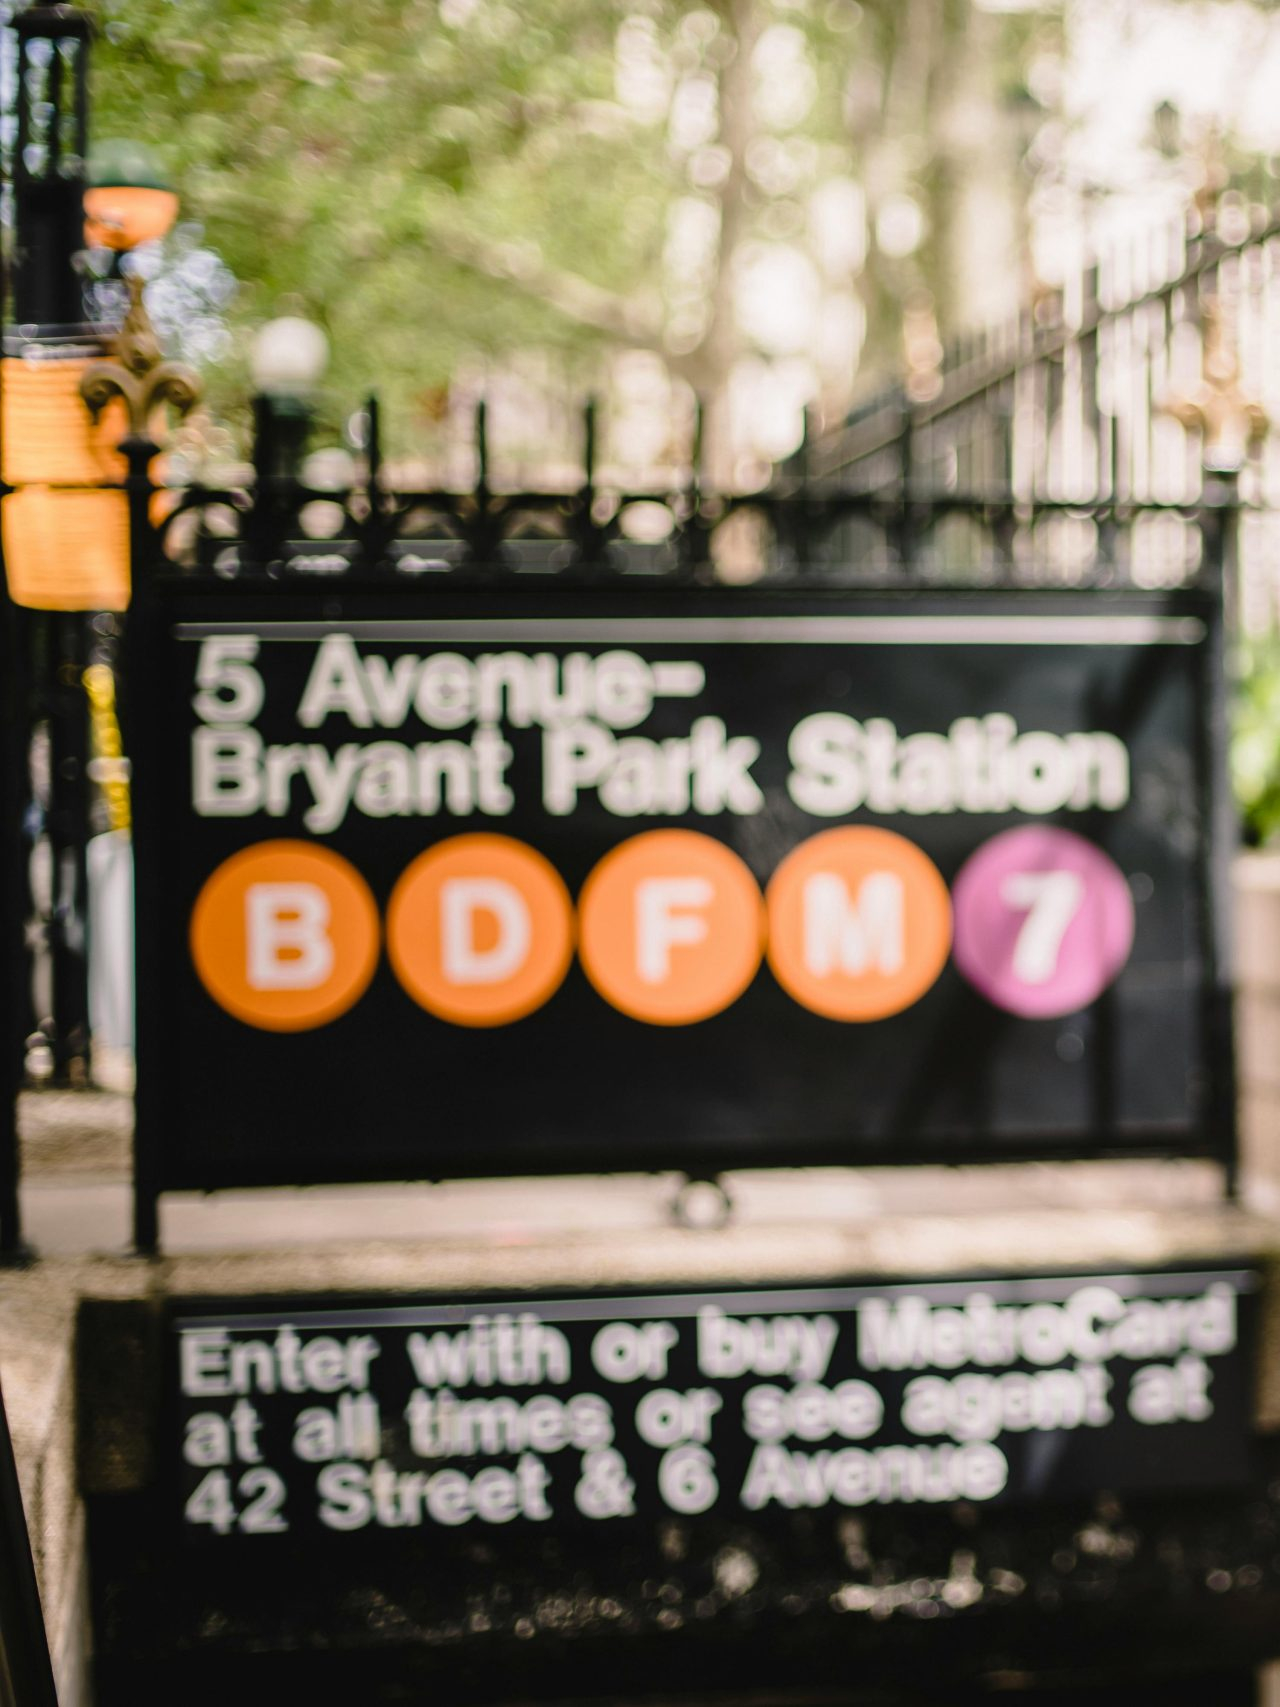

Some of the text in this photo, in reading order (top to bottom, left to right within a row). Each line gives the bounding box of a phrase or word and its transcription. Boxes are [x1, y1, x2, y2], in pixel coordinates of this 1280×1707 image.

[193, 634, 265, 727] 5
[192, 711, 1129, 834] Bryant Park Station
[245, 869, 1082, 991] B D F M 7
[180, 1281, 1237, 1397] Enter with or buy MetroCard
[184, 1352, 1213, 1467] at all times or see agent at
[185, 1440, 1008, 1534] 42 Street & 6 Avenue
